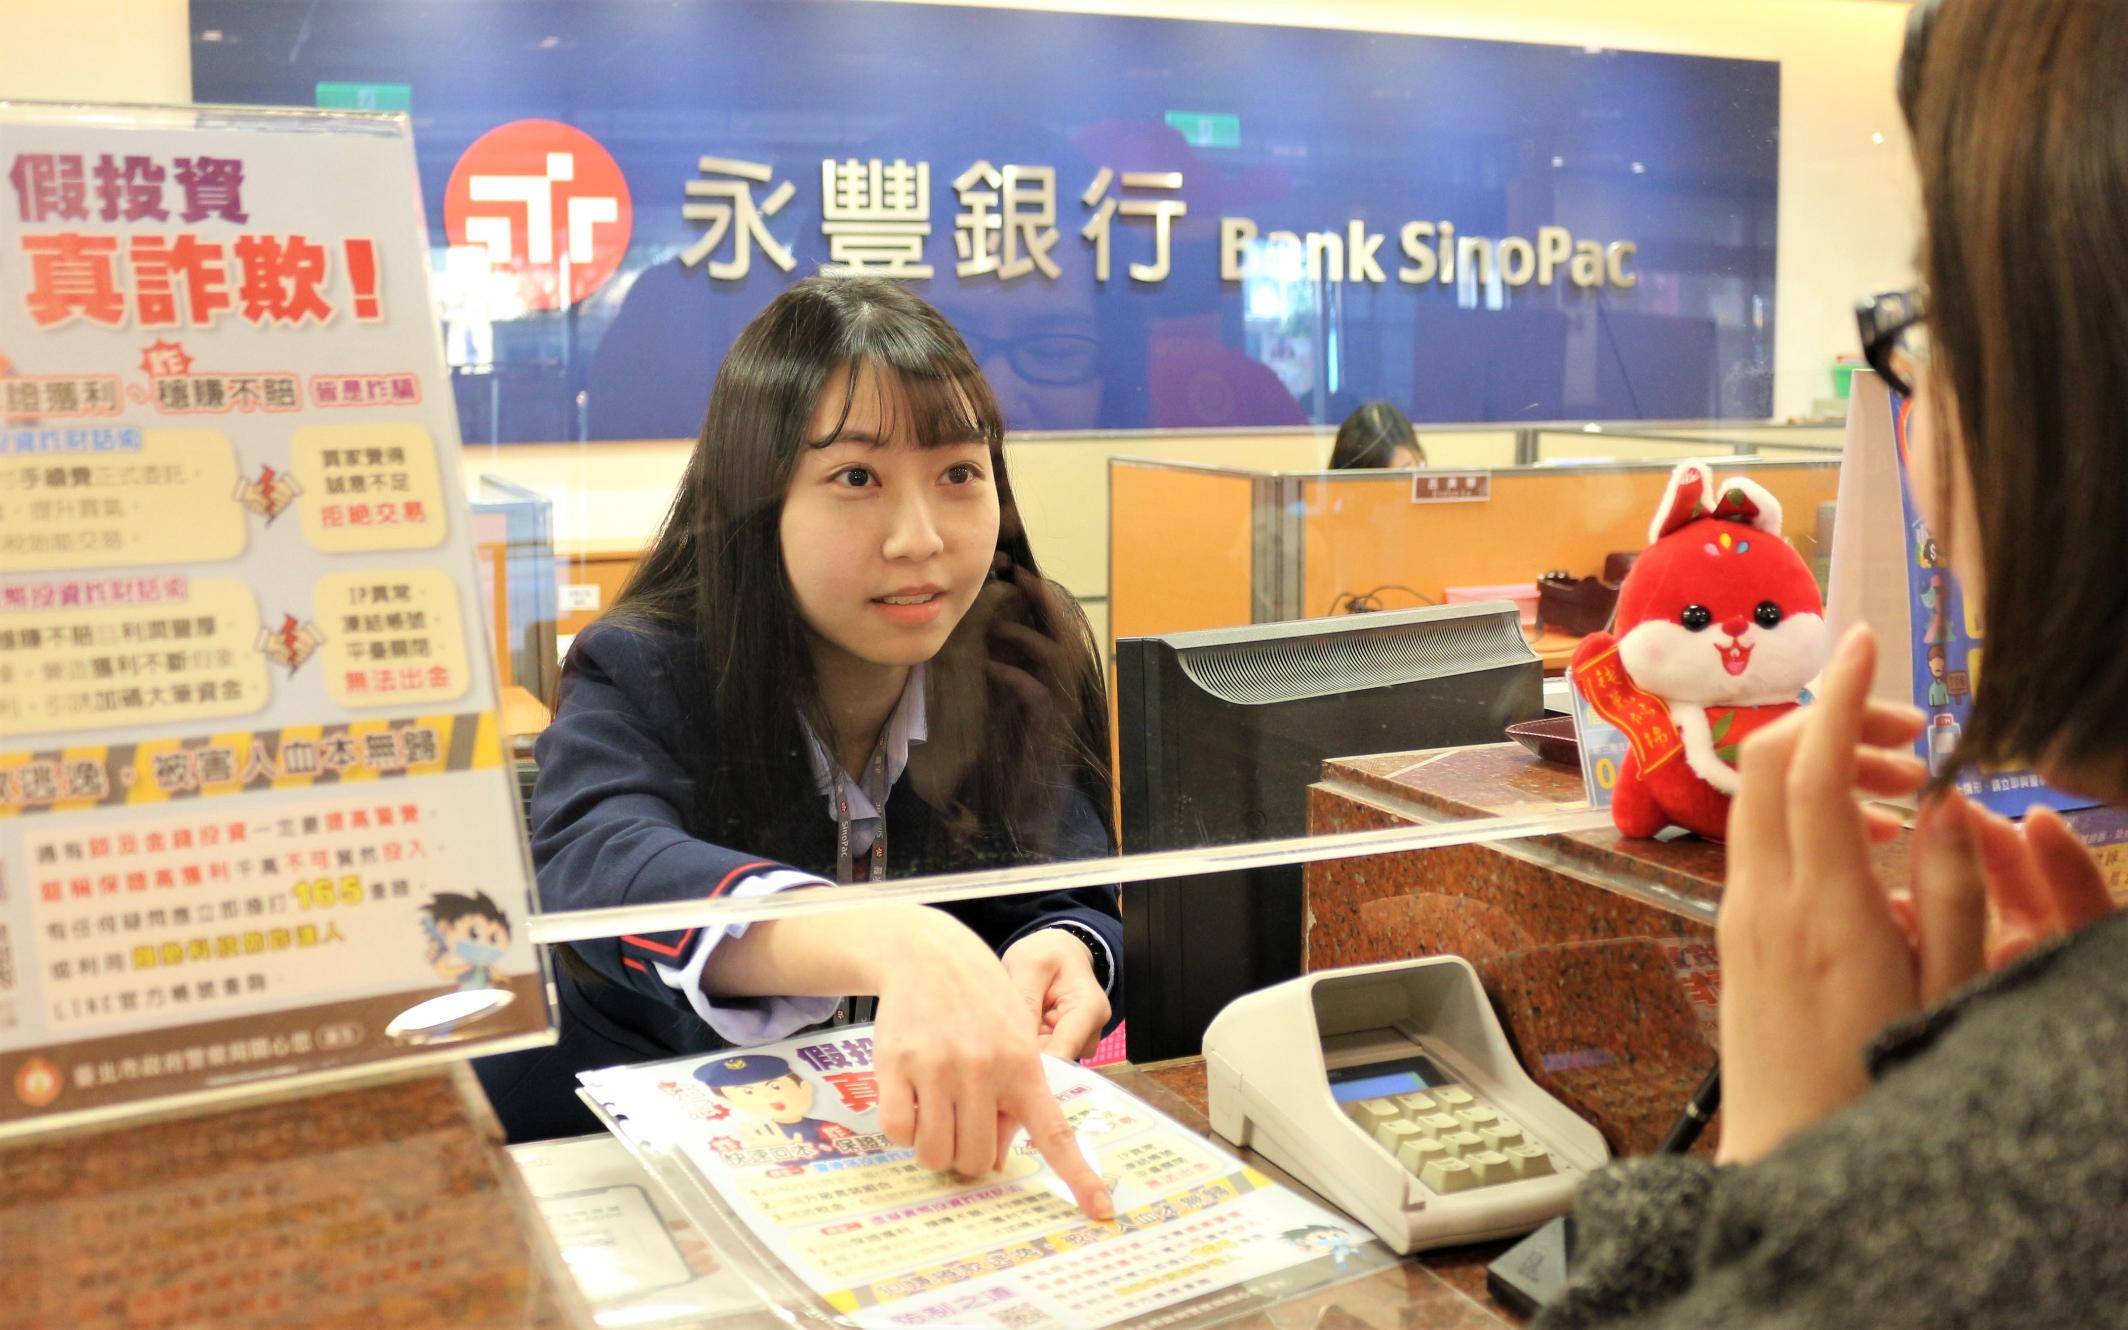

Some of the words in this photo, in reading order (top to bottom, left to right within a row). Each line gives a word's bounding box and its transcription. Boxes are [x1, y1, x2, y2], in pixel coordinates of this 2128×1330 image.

[9, 154, 249, 225] 假投資
[680, 156, 1187, 281] 永豐銀行
[1221, 217, 1387, 283] Bank
[1399, 219, 1637, 288] SinoPac
[320, 499, 427, 529] 拒絕交易
[345, 664, 450, 693] 無法出金
[841, 821, 849, 857] SinoPac
